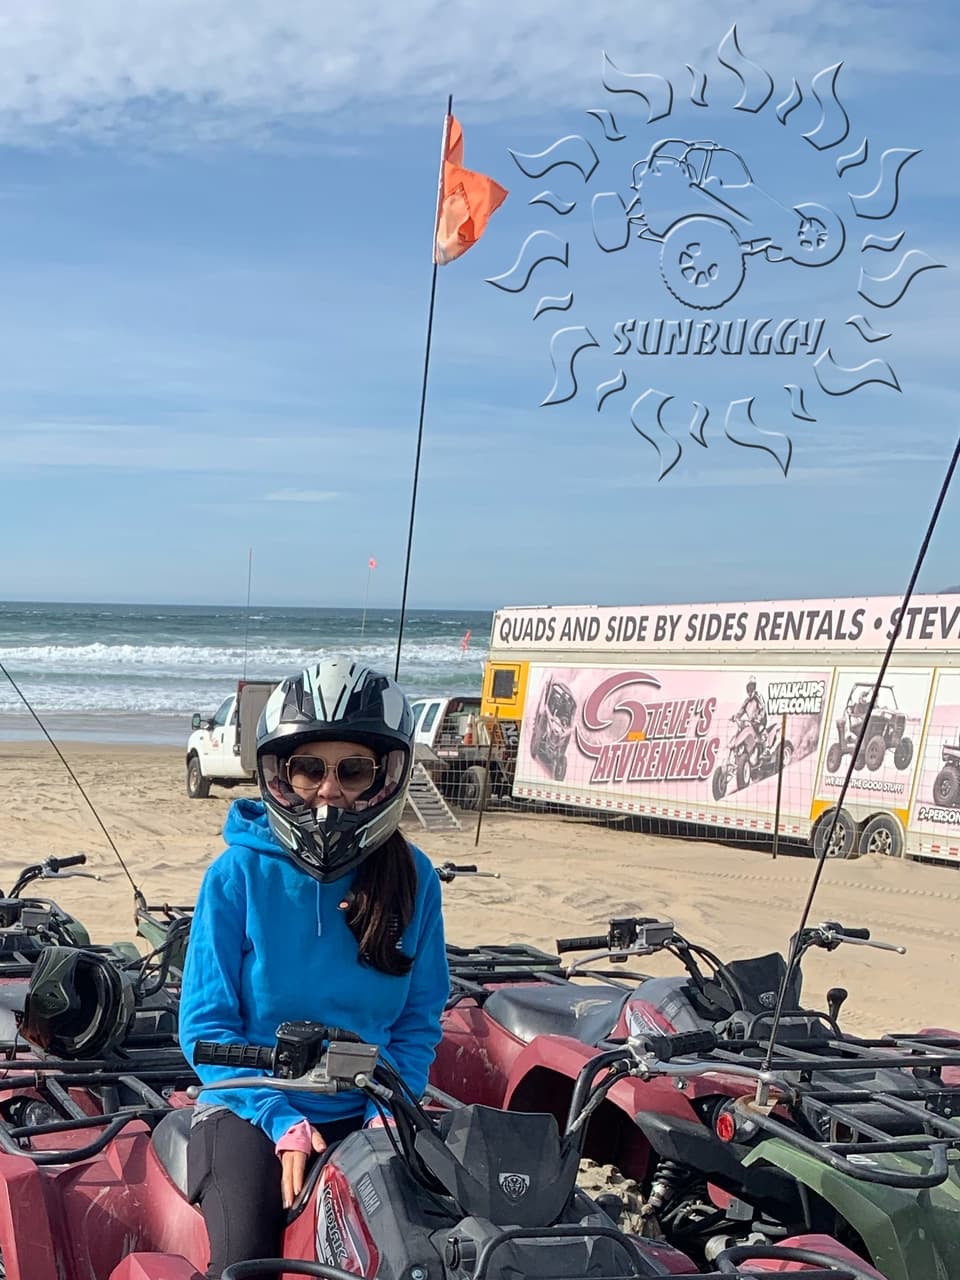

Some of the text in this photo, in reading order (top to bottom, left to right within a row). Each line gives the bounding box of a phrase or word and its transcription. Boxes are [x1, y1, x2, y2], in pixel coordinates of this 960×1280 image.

[499, 606, 960, 643] QUADS AND SIDE BY SIDES RENTALS STEV
[768, 681, 825, 699] WALK-UPS
[768, 697, 822, 715] WELCOME
[589, 737, 721, 783] ATV RENTALS
[862, 780, 883, 792] GOOD
[357, 1171, 381, 1216] YAMAHA
[323, 1181, 349, 1263] KODIAK
